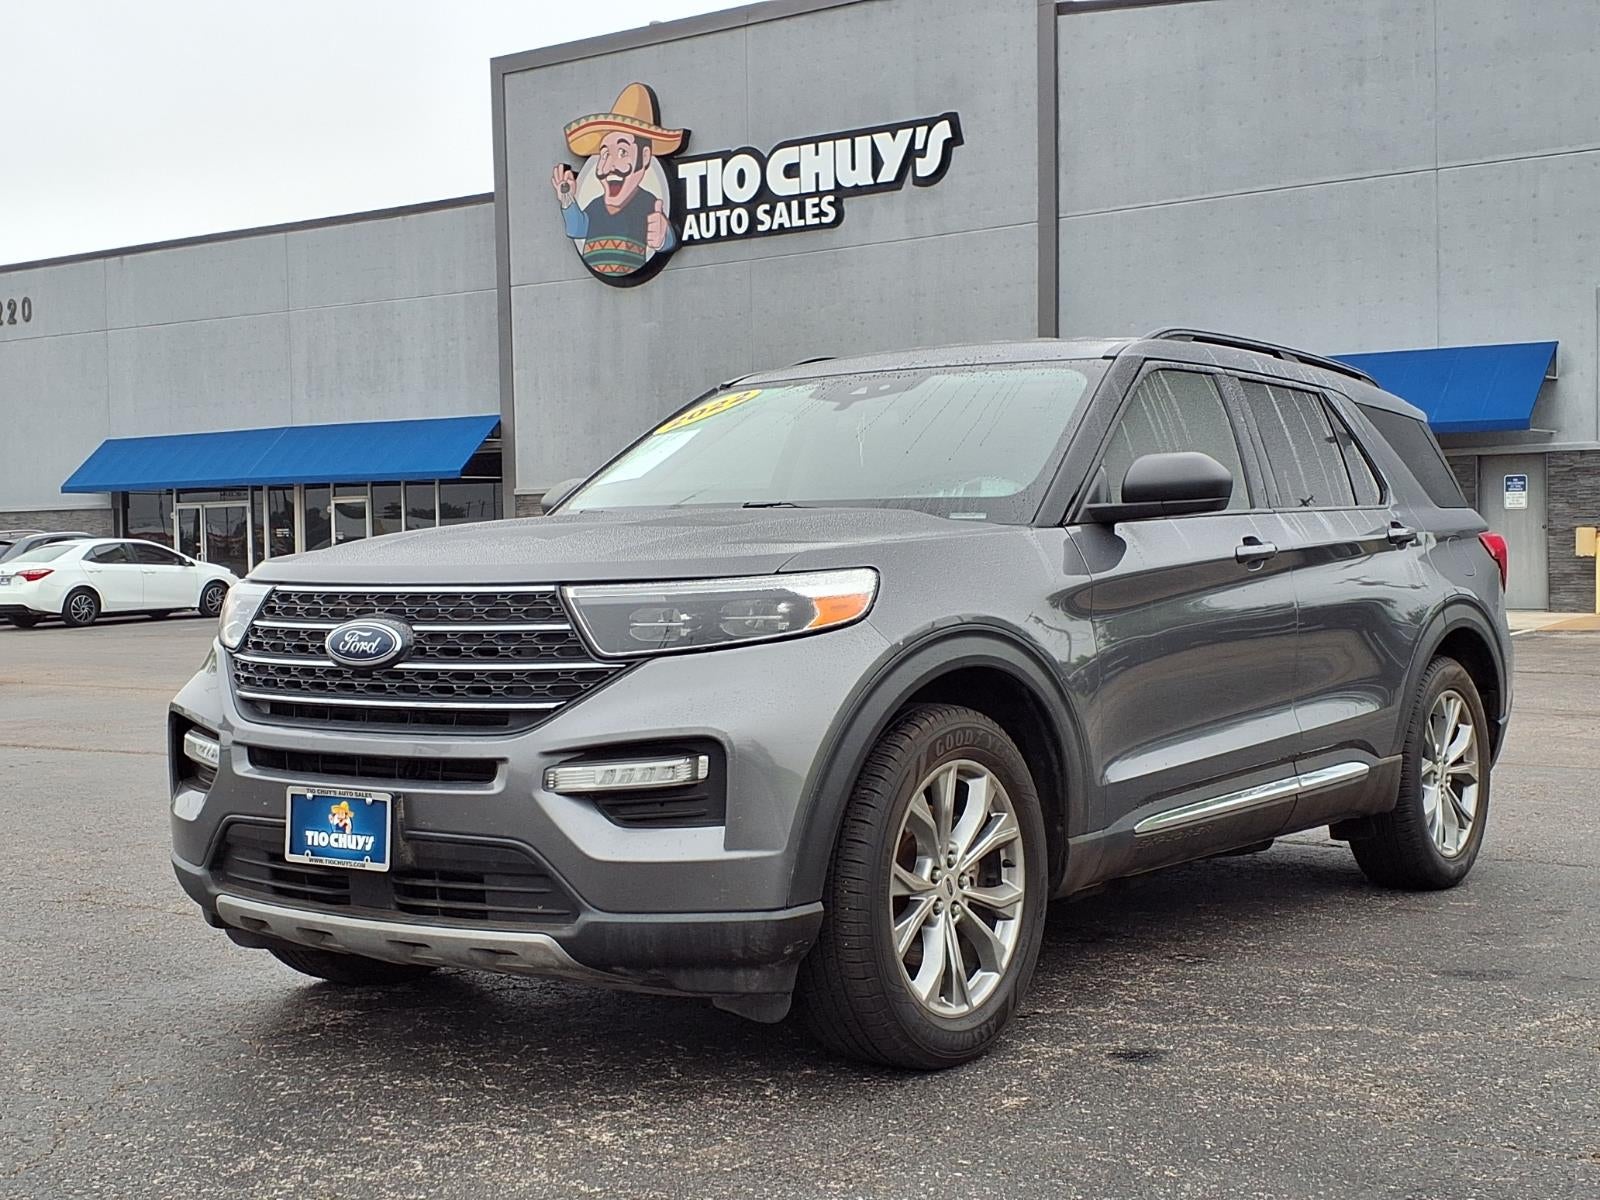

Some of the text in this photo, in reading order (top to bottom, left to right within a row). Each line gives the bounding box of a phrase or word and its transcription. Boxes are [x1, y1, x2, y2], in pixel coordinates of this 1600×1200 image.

[677, 119, 953, 210] TIO CHUY'S
[681, 195, 837, 242] AUTO SALES
[665, 391, 752, 429] 2022
[339, 629, 382, 654] Ford
[338, 789, 354, 797] AUTO
